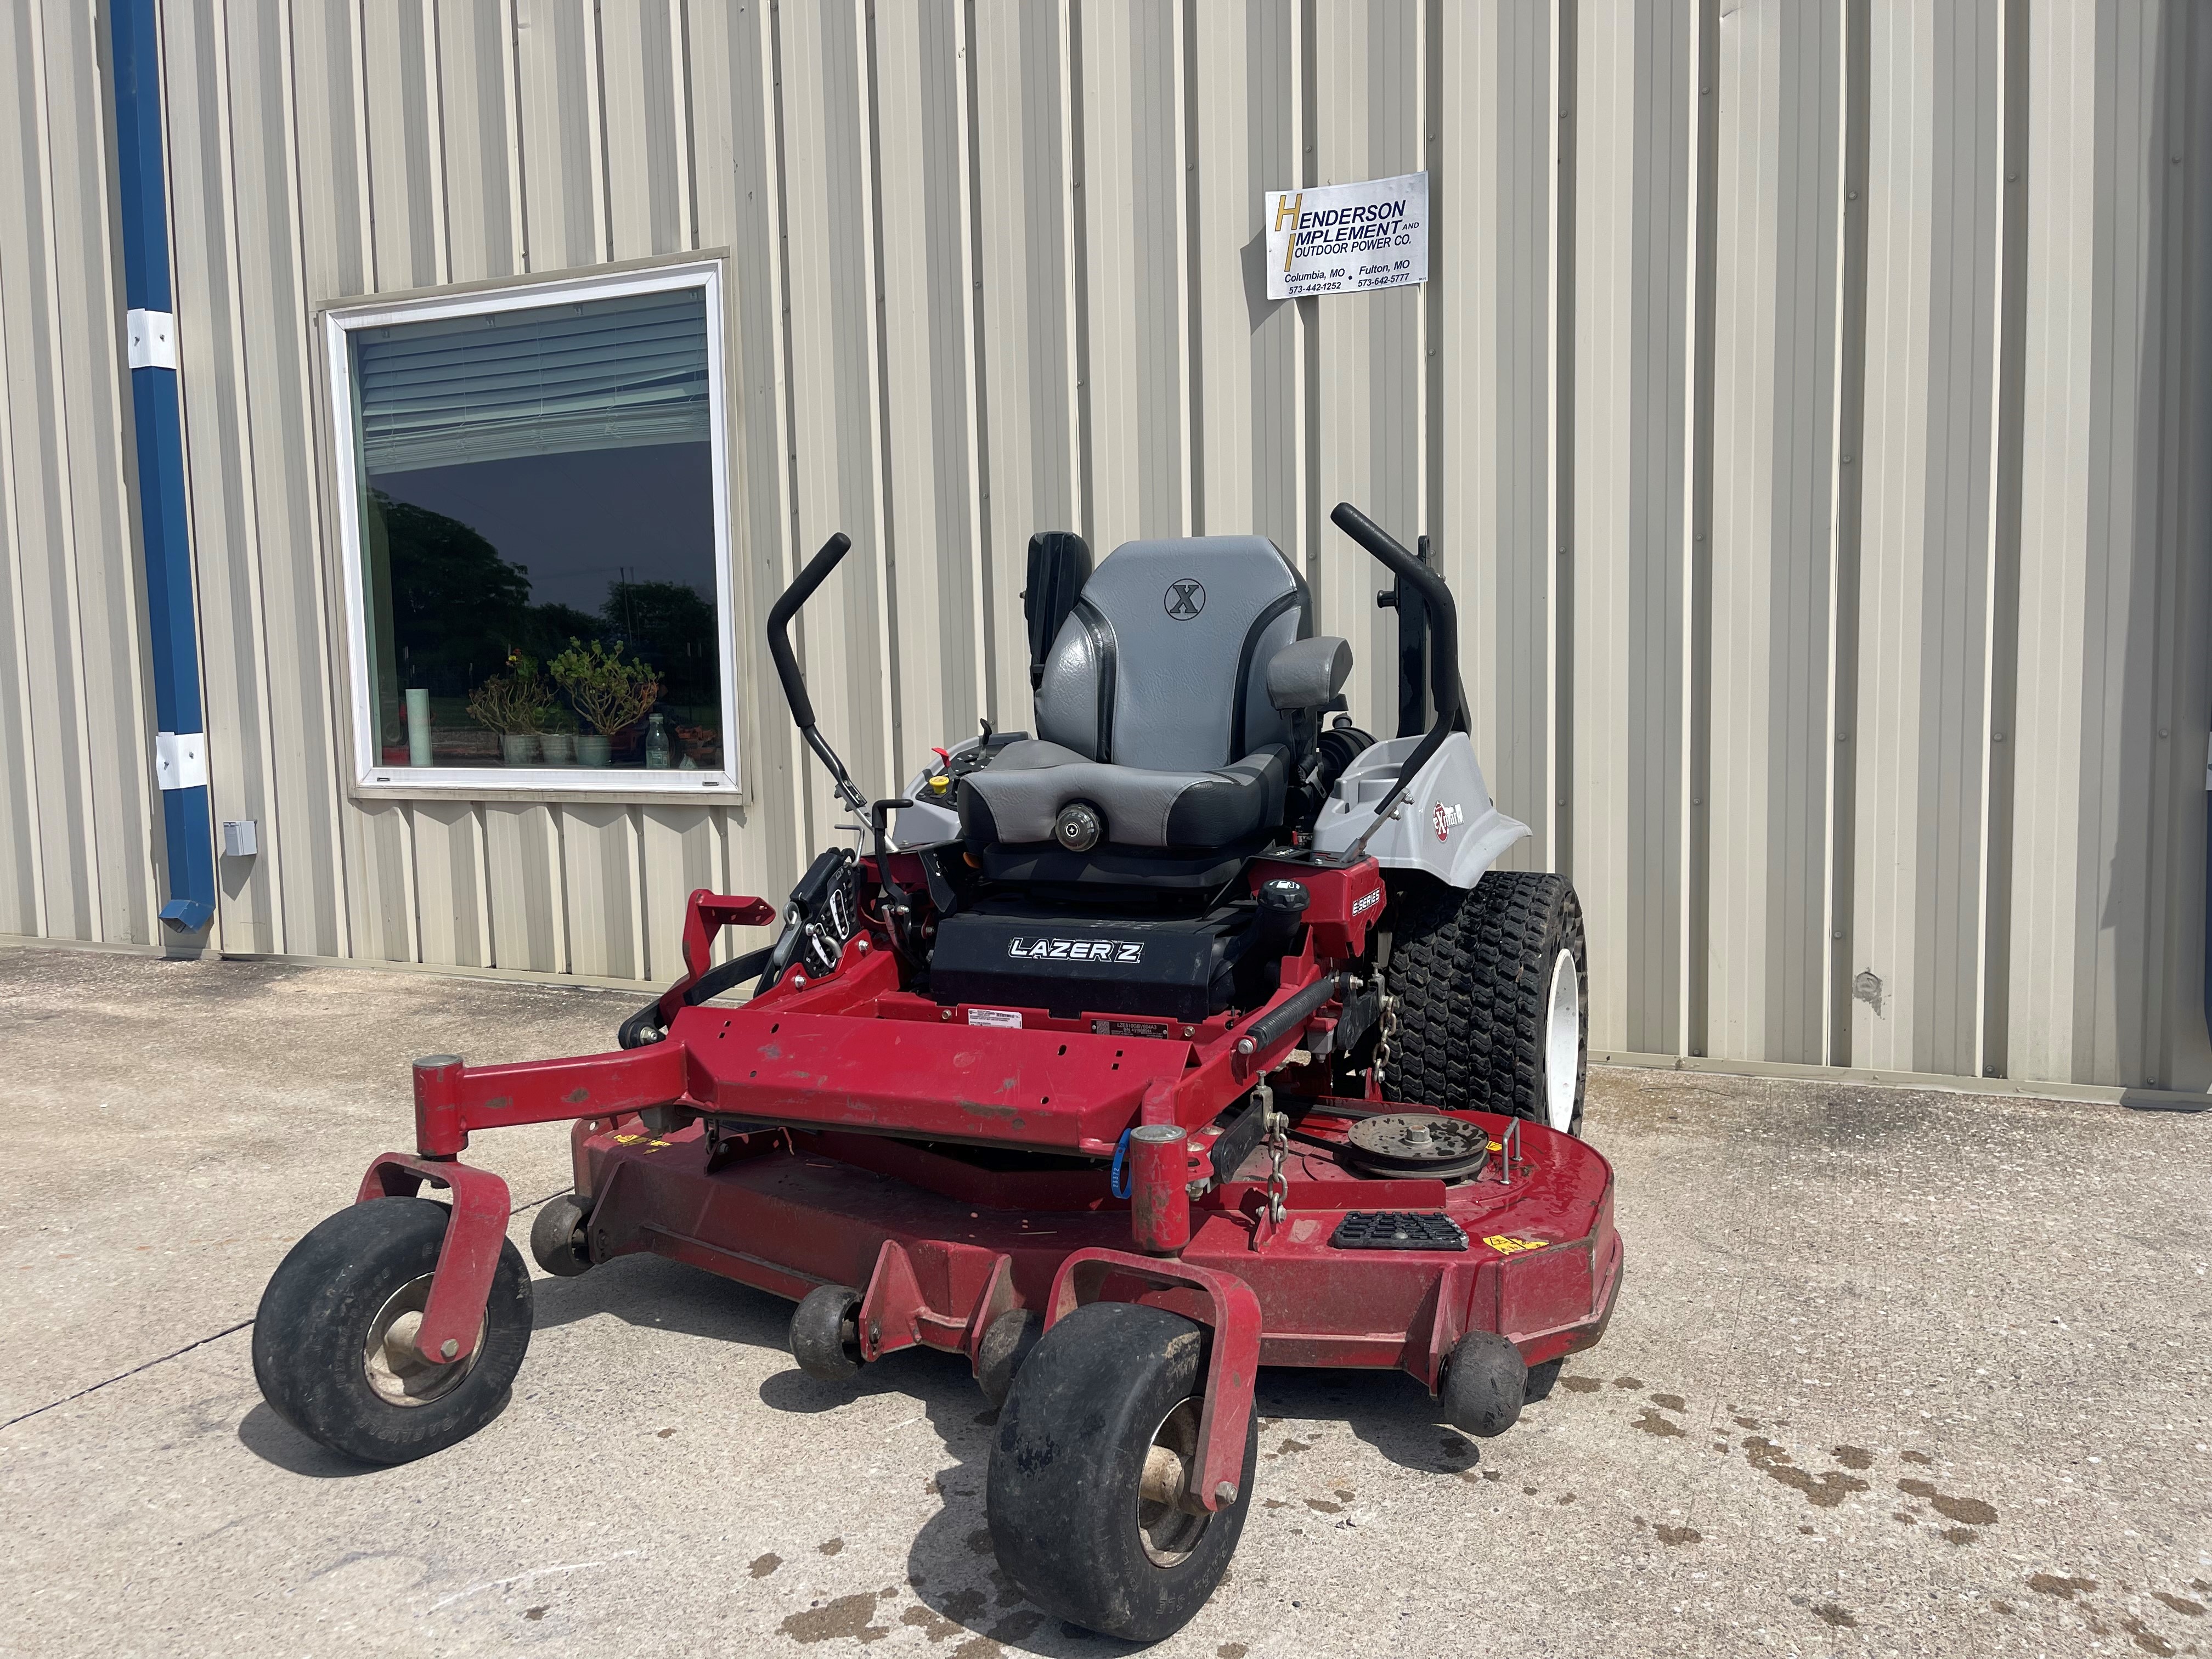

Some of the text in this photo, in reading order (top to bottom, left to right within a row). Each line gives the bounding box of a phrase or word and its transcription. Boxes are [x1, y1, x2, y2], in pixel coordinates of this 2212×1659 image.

[1274, 193, 1406, 232] HENDERSON
[1402, 222, 1419, 230] AND
[1295, 234, 1412, 258] OUTDOOR POWER CO.
[1359, 259, 1410, 275] Fulton, MO
[1284, 268, 1345, 283] Columbia, MO
[1358, 273, 1410, 287] 573-642-5777
[1289, 281, 1341, 294] 573-442-1252
[1352, 888, 1380, 916] E-SERIES
[1010, 939, 1142, 961] LAZER Z
